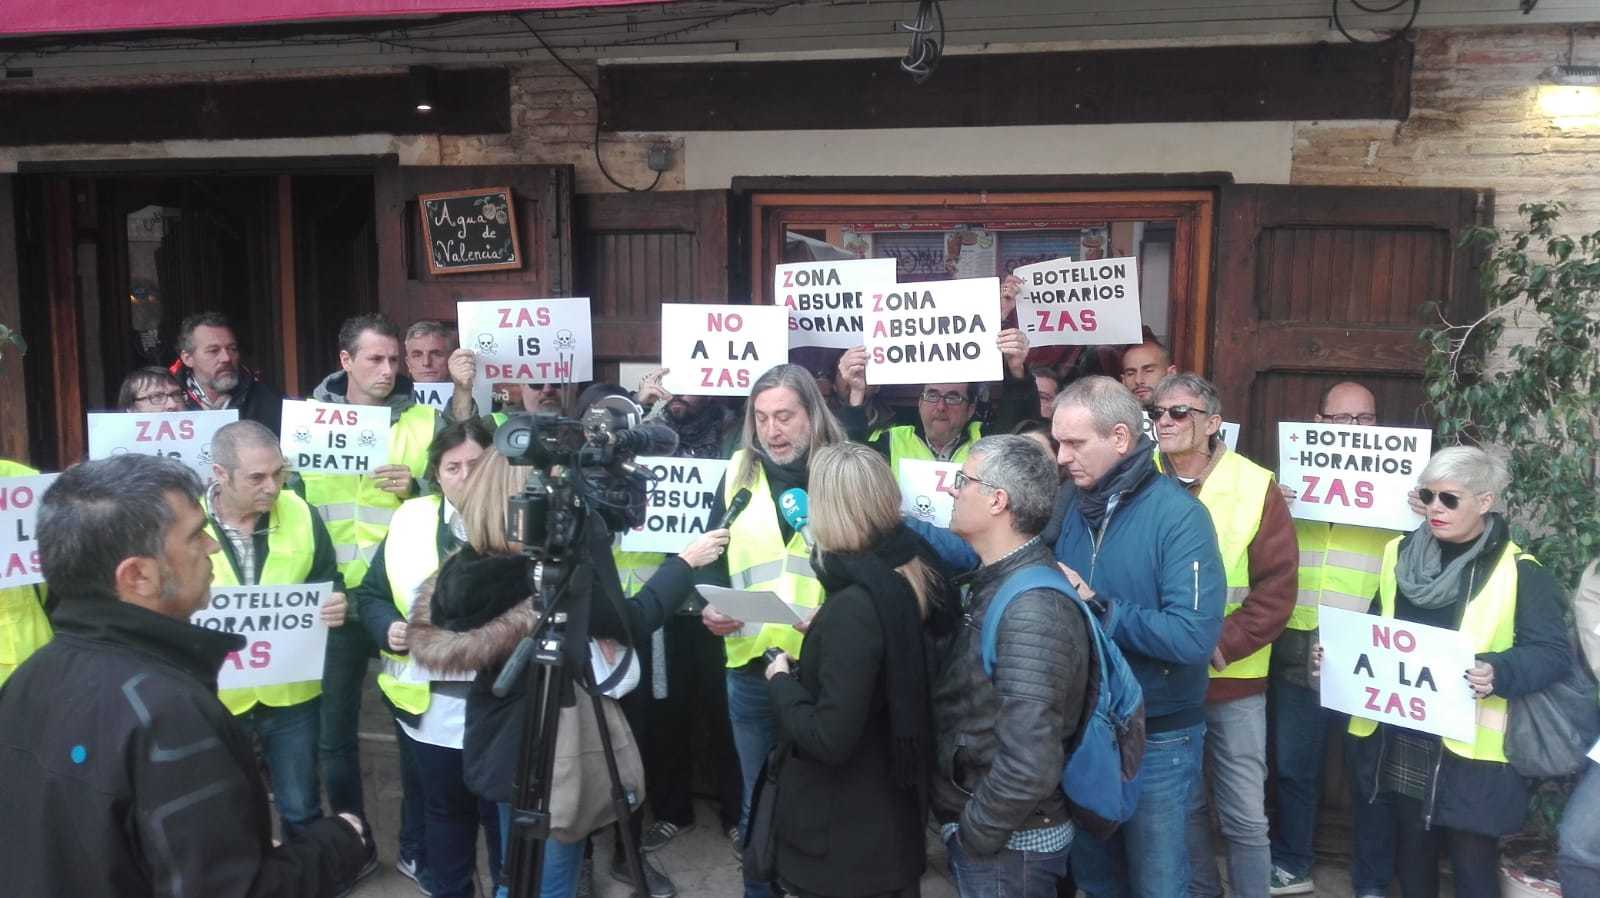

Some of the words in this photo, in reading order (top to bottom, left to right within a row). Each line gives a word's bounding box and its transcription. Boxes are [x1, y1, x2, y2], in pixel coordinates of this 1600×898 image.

[435, 201, 487, 239] Agua
[482, 224, 497, 239] de
[437, 240, 502, 262] Valencia
[783, 268, 842, 288] ZONA
[1032, 264, 1126, 287] BOTELLON
[872, 290, 936, 312] ZONA
[498, 308, 551, 328] ZAS
[707, 312, 743, 333] NO
[787, 314, 864, 333] SORIAN
[872, 314, 986, 338] ABSURDA
[691, 339, 709, 360] A
[728, 340, 760, 361] LA
[872, 341, 981, 364] SORIANO
[484, 360, 572, 380] DEATH
[700, 367, 751, 389] ZAS
[314, 408, 358, 426] ZAS
[135, 419, 195, 442] ZAS
[1305, 429, 1417, 452] BOTELLON
[298, 453, 369, 471] DEATH
[640, 464, 703, 484] ONA
[1301, 475, 1375, 509] ZAS
[211, 590, 320, 610] OTELLON
[1372, 624, 1417, 653] NO
[1353, 653, 1375, 678] A
[1399, 661, 1438, 692] LA
[1364, 686, 1427, 721] ZAS
